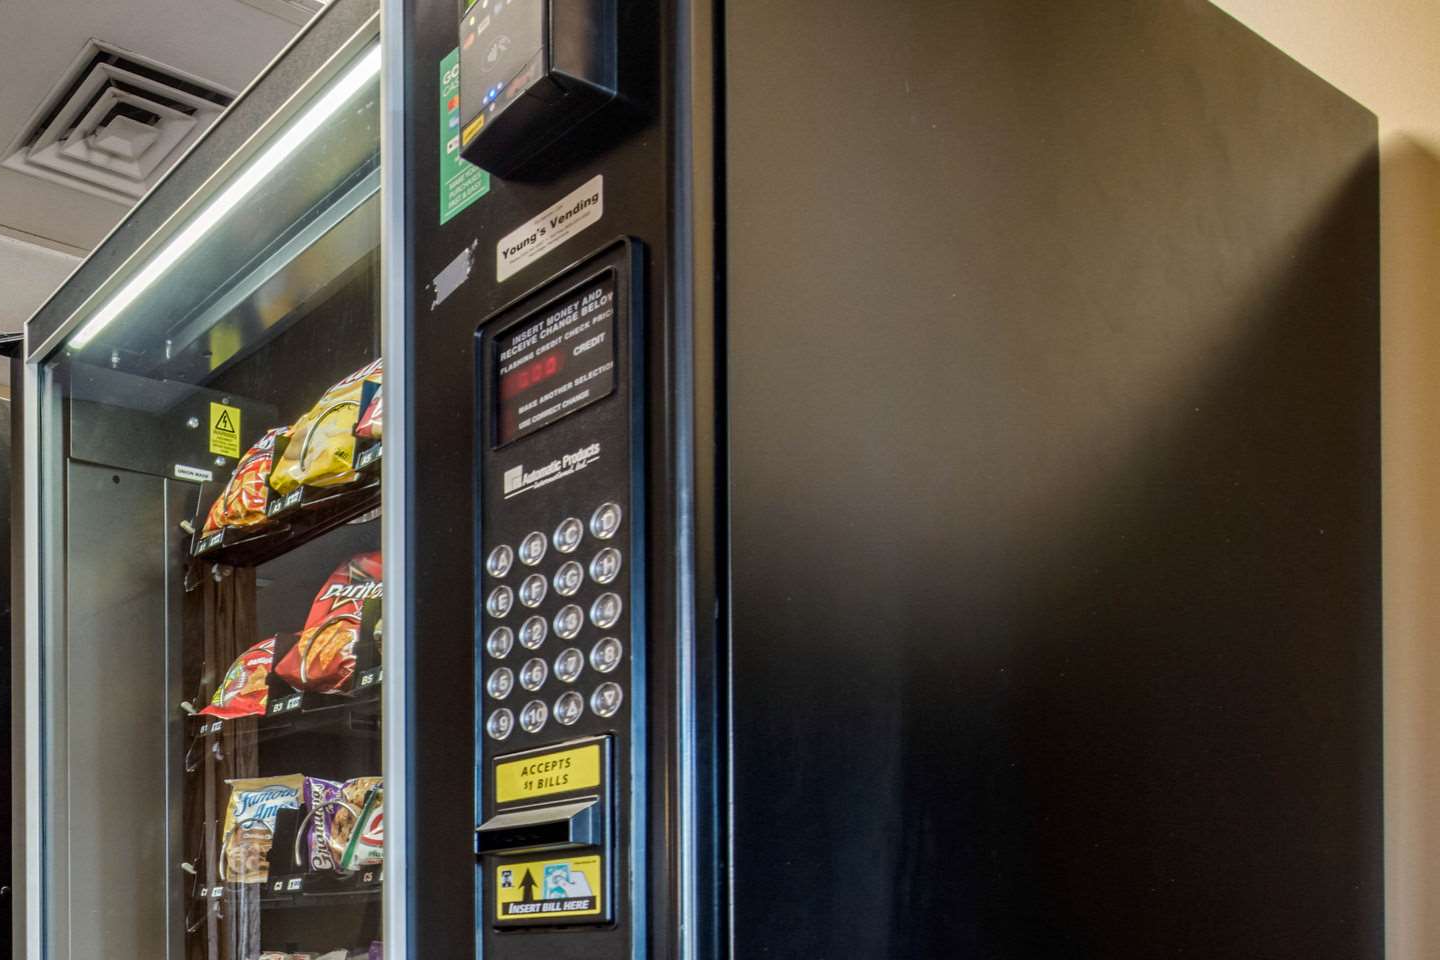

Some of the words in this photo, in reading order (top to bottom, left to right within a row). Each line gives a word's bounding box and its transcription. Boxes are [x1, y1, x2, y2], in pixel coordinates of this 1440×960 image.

[502, 226, 547, 260] Young's
[549, 192, 600, 229] Vending
[512, 320, 545, 346] INSERT
[546, 301, 580, 326] MONEY
[582, 289, 603, 306] AND
[535, 335, 563, 356] CREDIT
[564, 320, 591, 340] CHECK
[592, 308, 614, 325] PRIC
[500, 334, 538, 362] RECEIVE
[540, 311, 578, 339] CHANGE
[572, 332, 606, 357] CREDIT
[518, 399, 538, 415] MAKE
[539, 381, 574, 405] ANOTHER
[531, 403, 562, 424] CORRECT
[562, 389, 590, 408] CHANGE
[522, 460, 562, 487] Automatic
[562, 443, 601, 469] Products
[320, 581, 384, 600] Dorito
[273, 703, 283, 713] B3
[520, 757, 572, 777] ACCEPTS
[523, 781, 534, 791] $1
[537, 774, 569, 789] BILLS
[234, 788, 298, 817] Famous
[508, 902, 541, 915] INSERT
[542, 902, 562, 912] BILL
[563, 899, 590, 911] HERE
